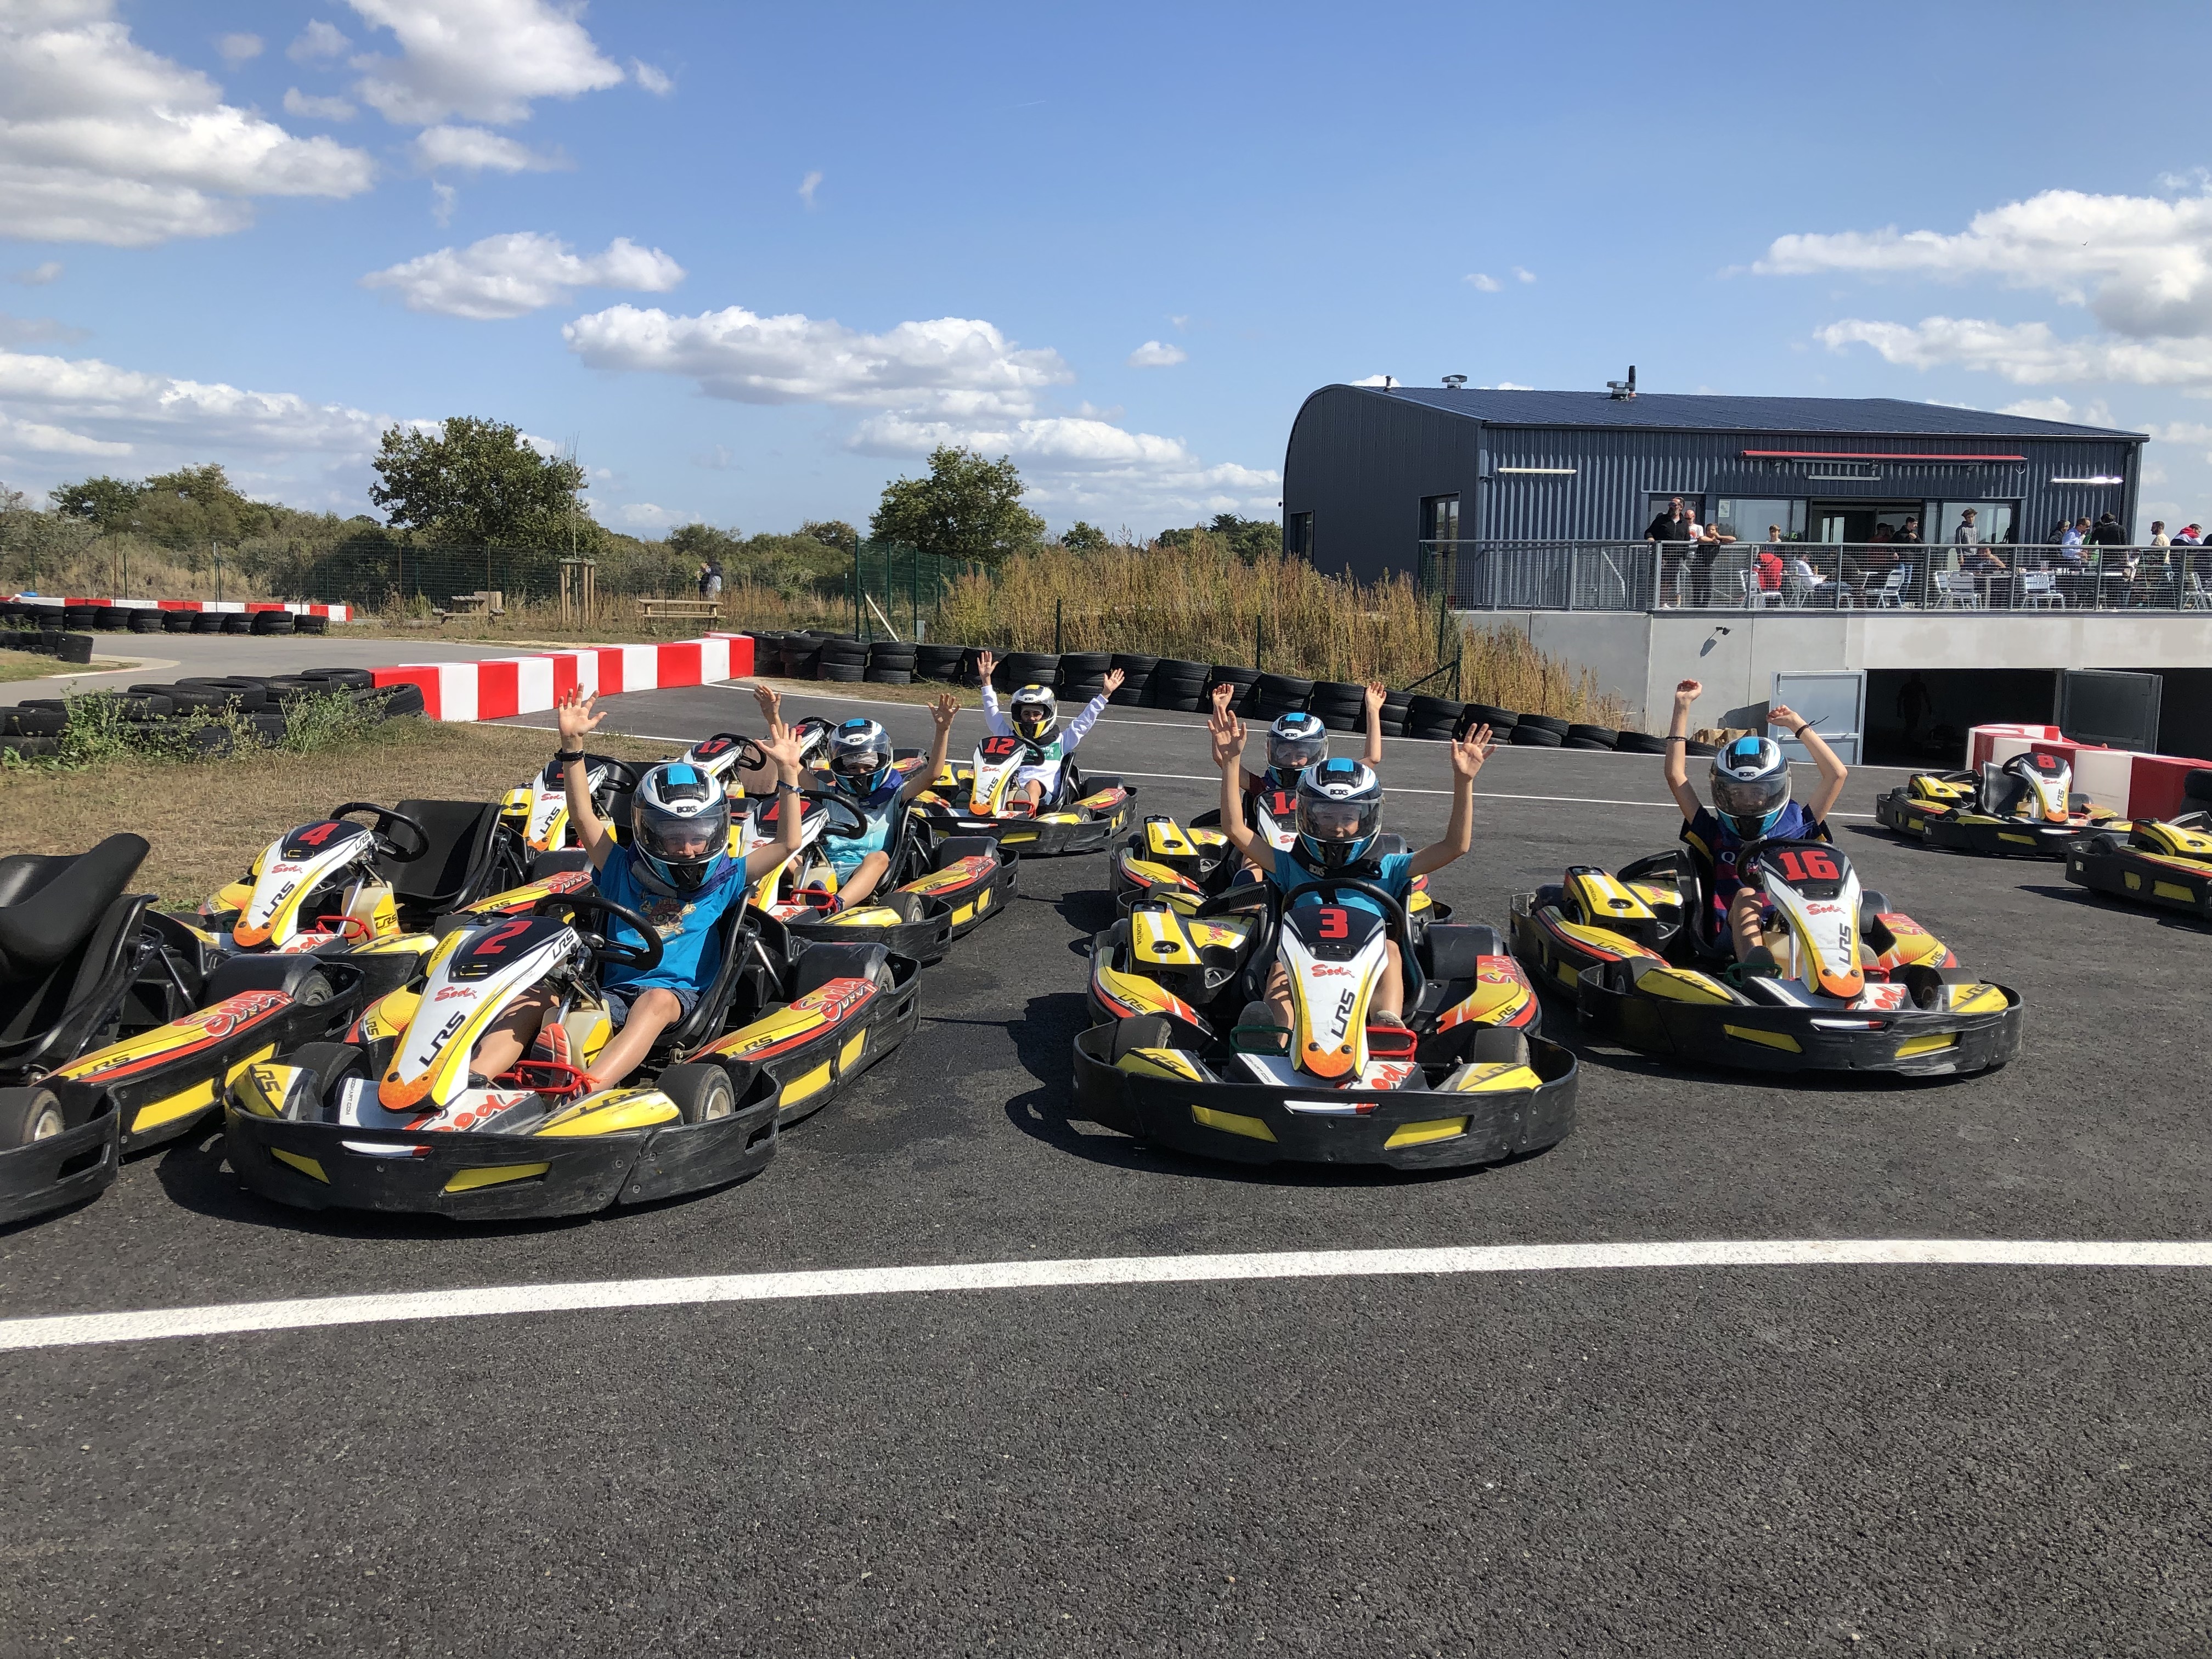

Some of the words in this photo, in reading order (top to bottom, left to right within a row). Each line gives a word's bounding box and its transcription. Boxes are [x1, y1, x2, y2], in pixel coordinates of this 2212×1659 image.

[697, 741, 730, 753] 17
[984, 737, 1015, 754] 12
[2036, 755, 2056, 769] 8
[986, 777, 999, 799] LRS
[2056, 789, 2065, 808] LRS
[539, 806, 561, 835] LRS
[298, 823, 340, 845] 4
[355, 829, 370, 851] LRS
[271, 864, 303, 874] Sodi
[1779, 850, 1839, 881] 16
[262, 881, 296, 919] LRS
[1587, 883, 1598, 902] HONDA
[481, 900, 511, 913] LRS
[1806, 903, 1846, 915] Sodi
[375, 912, 397, 929] LRS
[1319, 909, 1348, 938] 3
[472, 920, 533, 955] 2
[552, 930, 575, 961] LRS
[1838, 923, 1852, 966] LRS
[432, 937, 453, 963] HONDA
[1596, 942, 1629, 956] LRS
[1927, 951, 1944, 966] LRS
[1311, 964, 1355, 979] Sodi
[434, 986, 478, 1002] Sodi
[1118, 994, 1149, 1011] LRS
[1331, 988, 1356, 1040] LRS
[1492, 1005, 1516, 1023] LRS
[365, 1016, 380, 1036] LRS
[419, 1010, 466, 1068] LRS
[732, 1035, 774, 1057] LRS
[77, 1053, 131, 1079] LRS
[250, 1064, 281, 1093] RS
